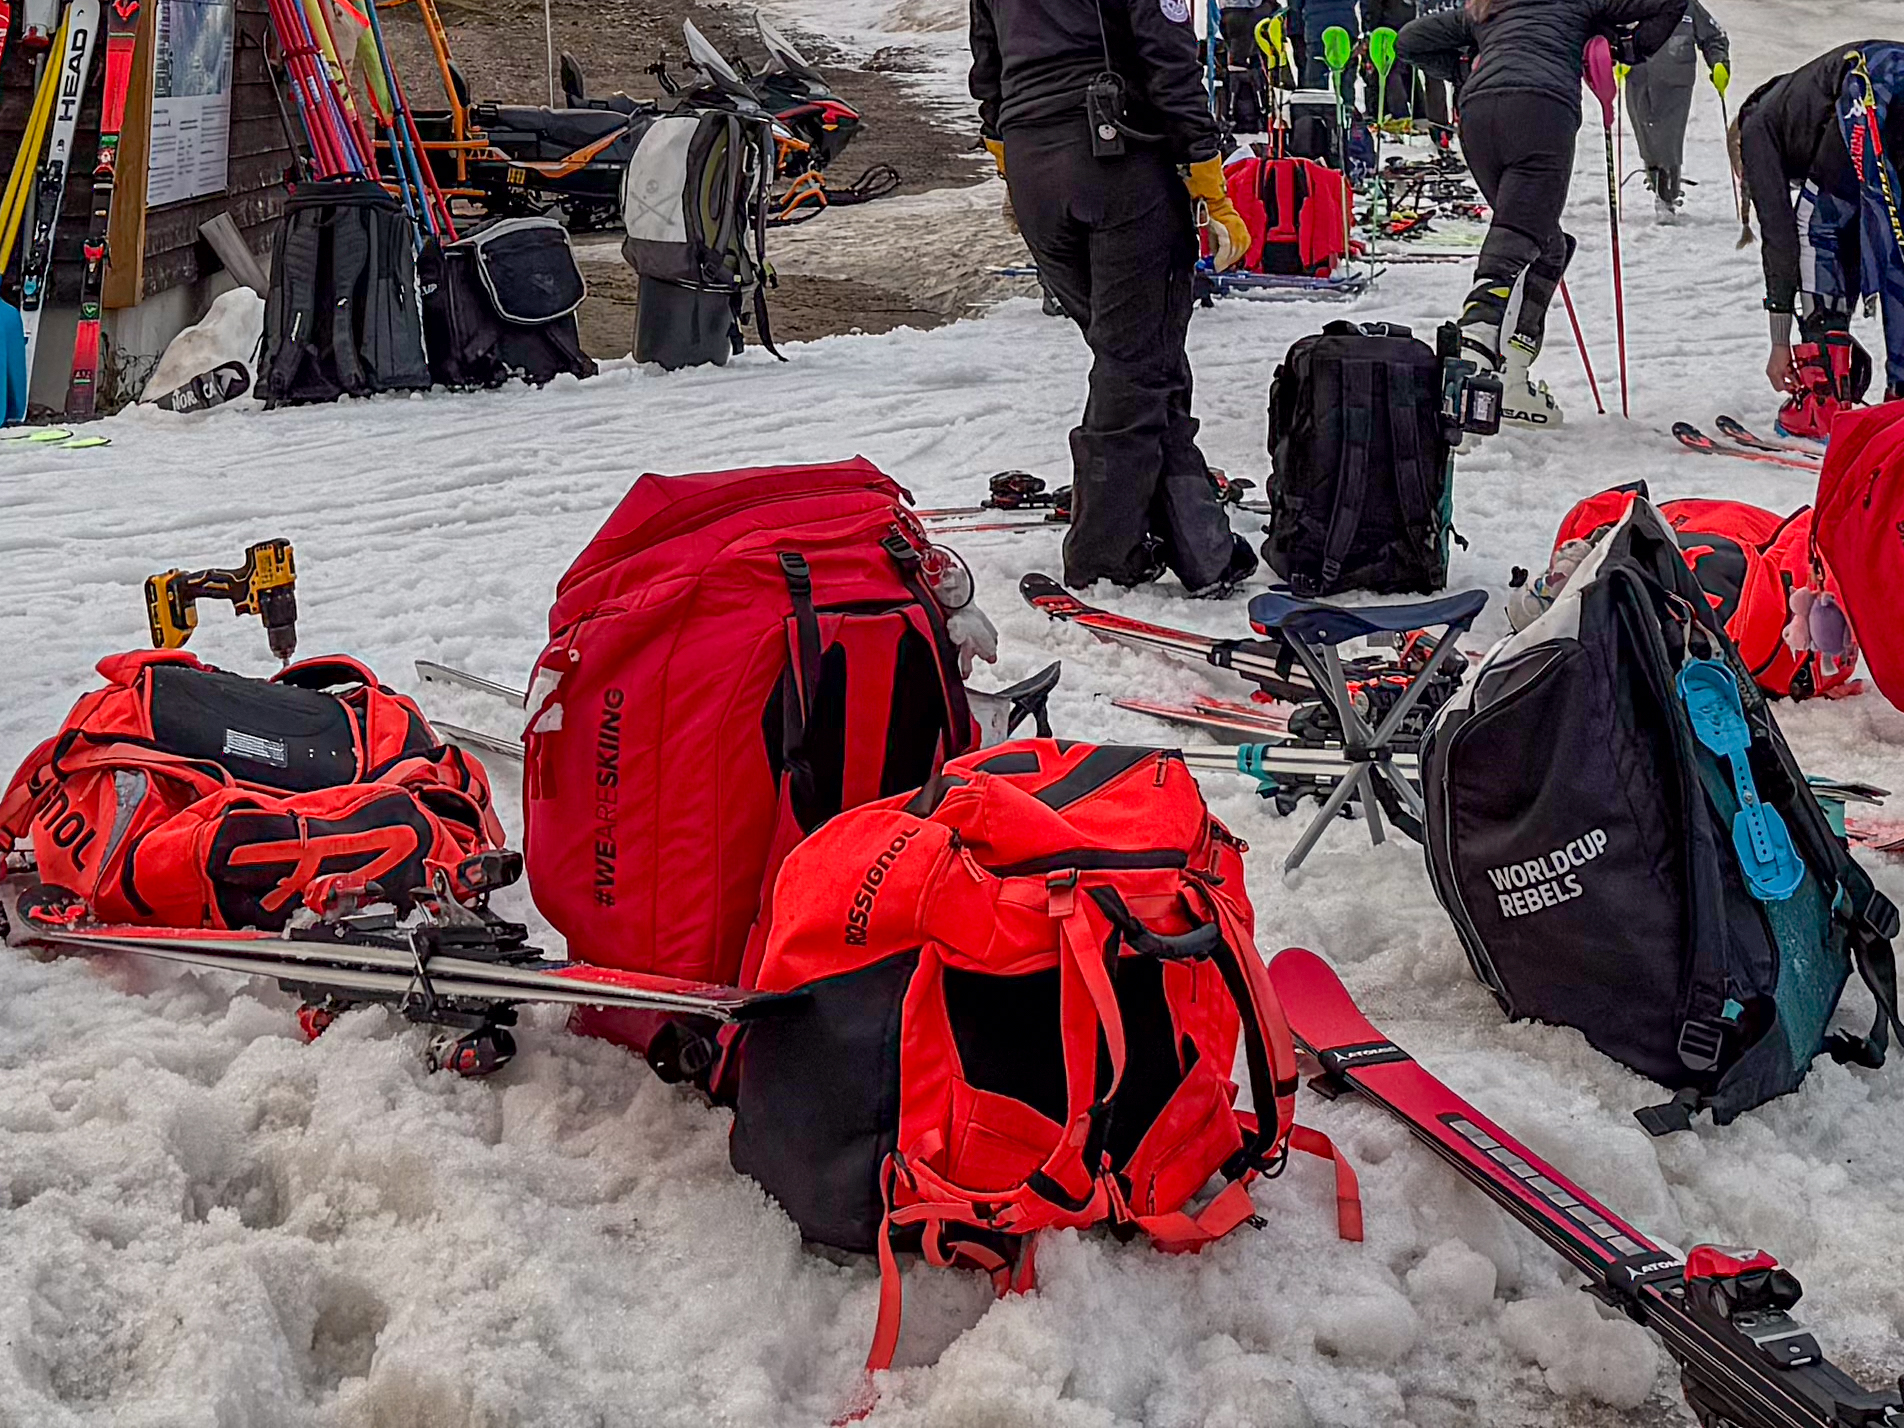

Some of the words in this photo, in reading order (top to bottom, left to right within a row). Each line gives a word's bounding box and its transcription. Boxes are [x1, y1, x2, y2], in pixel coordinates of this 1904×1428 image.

[57, 28, 89, 123] HEAD
[1500, 407, 1548, 424] EAD
[594, 687, 625, 908] #WEARESKIING
[1487, 828, 1609, 892] WORLDCUP
[1497, 873, 1584, 918] REBELS
